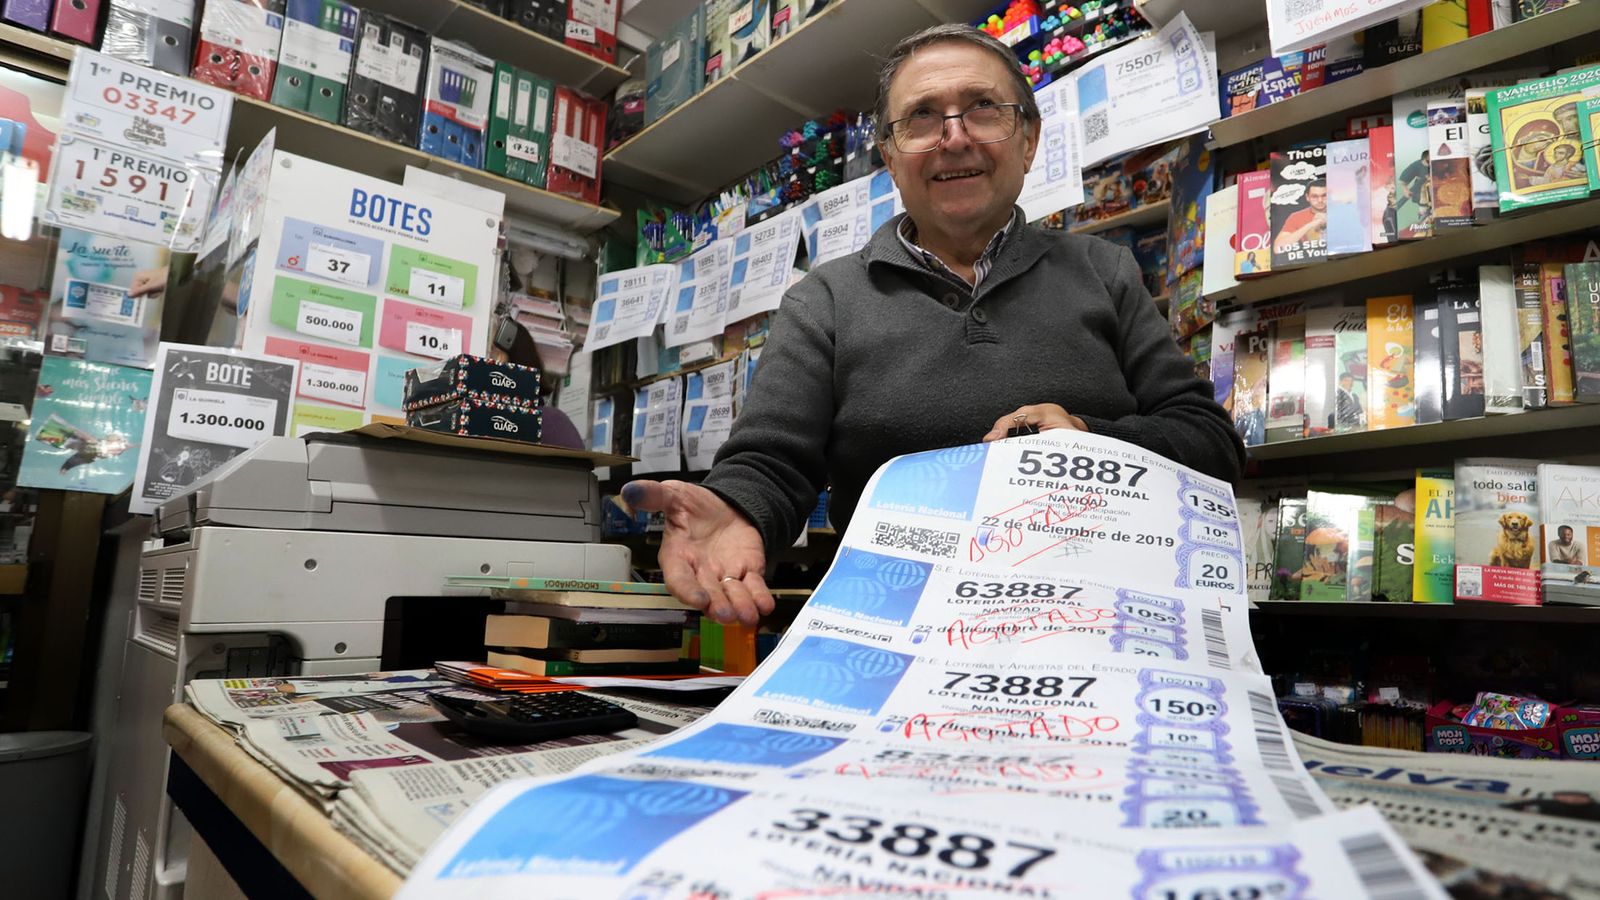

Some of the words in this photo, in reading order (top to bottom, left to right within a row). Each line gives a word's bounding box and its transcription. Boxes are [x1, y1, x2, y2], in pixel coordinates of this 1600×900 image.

[1115, 50, 1163, 76] 75507
[119, 71, 215, 111] PREMIO
[1496, 76, 1568, 100] EVANGELIO
[103, 86, 197, 125] 03347
[1445, 127, 1464, 141] El
[110, 152, 189, 184] PREMIO
[349, 188, 433, 236] BOTES
[1277, 241, 1300, 254] LOS
[1302, 239, 1327, 251] SEC
[1288, 250, 1305, 261] DE
[327, 258, 351, 274] 37
[427, 282, 446, 297] 11
[305, 314, 354, 332] 500.000
[418, 335, 449, 351] 10,8
[205, 361, 254, 387] BOTE
[305, 378, 359, 393] 1.300.000
[179, 411, 265, 432] 1.300.000
[1018, 437, 1061, 448] LOTERÍAS
[1072, 441, 1119, 457] APUESTAS
[1121, 451, 1139, 462] DEL
[1141, 456, 1177, 473] ESTADO
[1017, 448, 1148, 488] 53887
[1008, 476, 1070, 491] LOTERÍA
[1074, 483, 1150, 501] NACIONAL
[1473, 479, 1504, 491] todo
[1047, 493, 1109, 509] NAVIDAD
[1496, 491, 1528, 504] bien
[1089, 511, 1104, 521] del
[1105, 513, 1118, 523] día
[980, 515, 999, 527] 22
[1003, 519, 1023, 530] de
[1027, 520, 1107, 540] diciembre
[1110, 530, 1131, 544] de
[1135, 533, 1175, 548] 2019
[1201, 550, 1230, 560] PRECIO
[1201, 563, 1229, 580] 20
[954, 580, 1084, 600] 63887
[1195, 579, 1236, 591] EUROS
[946, 597, 1006, 606] LOTERÍA
[1010, 598, 1085, 608] NACIONAL
[981, 605, 1041, 614] NAVIDAD
[813, 602, 854, 619] Lotería
[854, 611, 905, 627] Nacional
[915, 624, 934, 633] 22
[937, 625, 956, 634] de
[1042, 624, 1063, 633] de
[1068, 625, 1107, 636] 2019
[947, 605, 1118, 650] AGOTADO
[1007, 661, 1064, 673] APUESTAS
[1066, 664, 1088, 673] DEL
[1091, 662, 1138, 675] ESTADO
[942, 670, 1098, 698] 73887
[927, 688, 999, 703] LOTERÍA
[1013, 696, 1100, 710] NACIONAL
[971, 703, 1045, 719] NAVIDAD
[904, 712, 1120, 743] AGOTADO
[913, 717, 936, 728] de
[1437, 729, 1463, 739] MOJI
[1439, 736, 1464, 746] POPS
[1304, 760, 1511, 795] elva
[748, 827, 874, 867] LOTERÍA
[771, 807, 1058, 880] 33887
